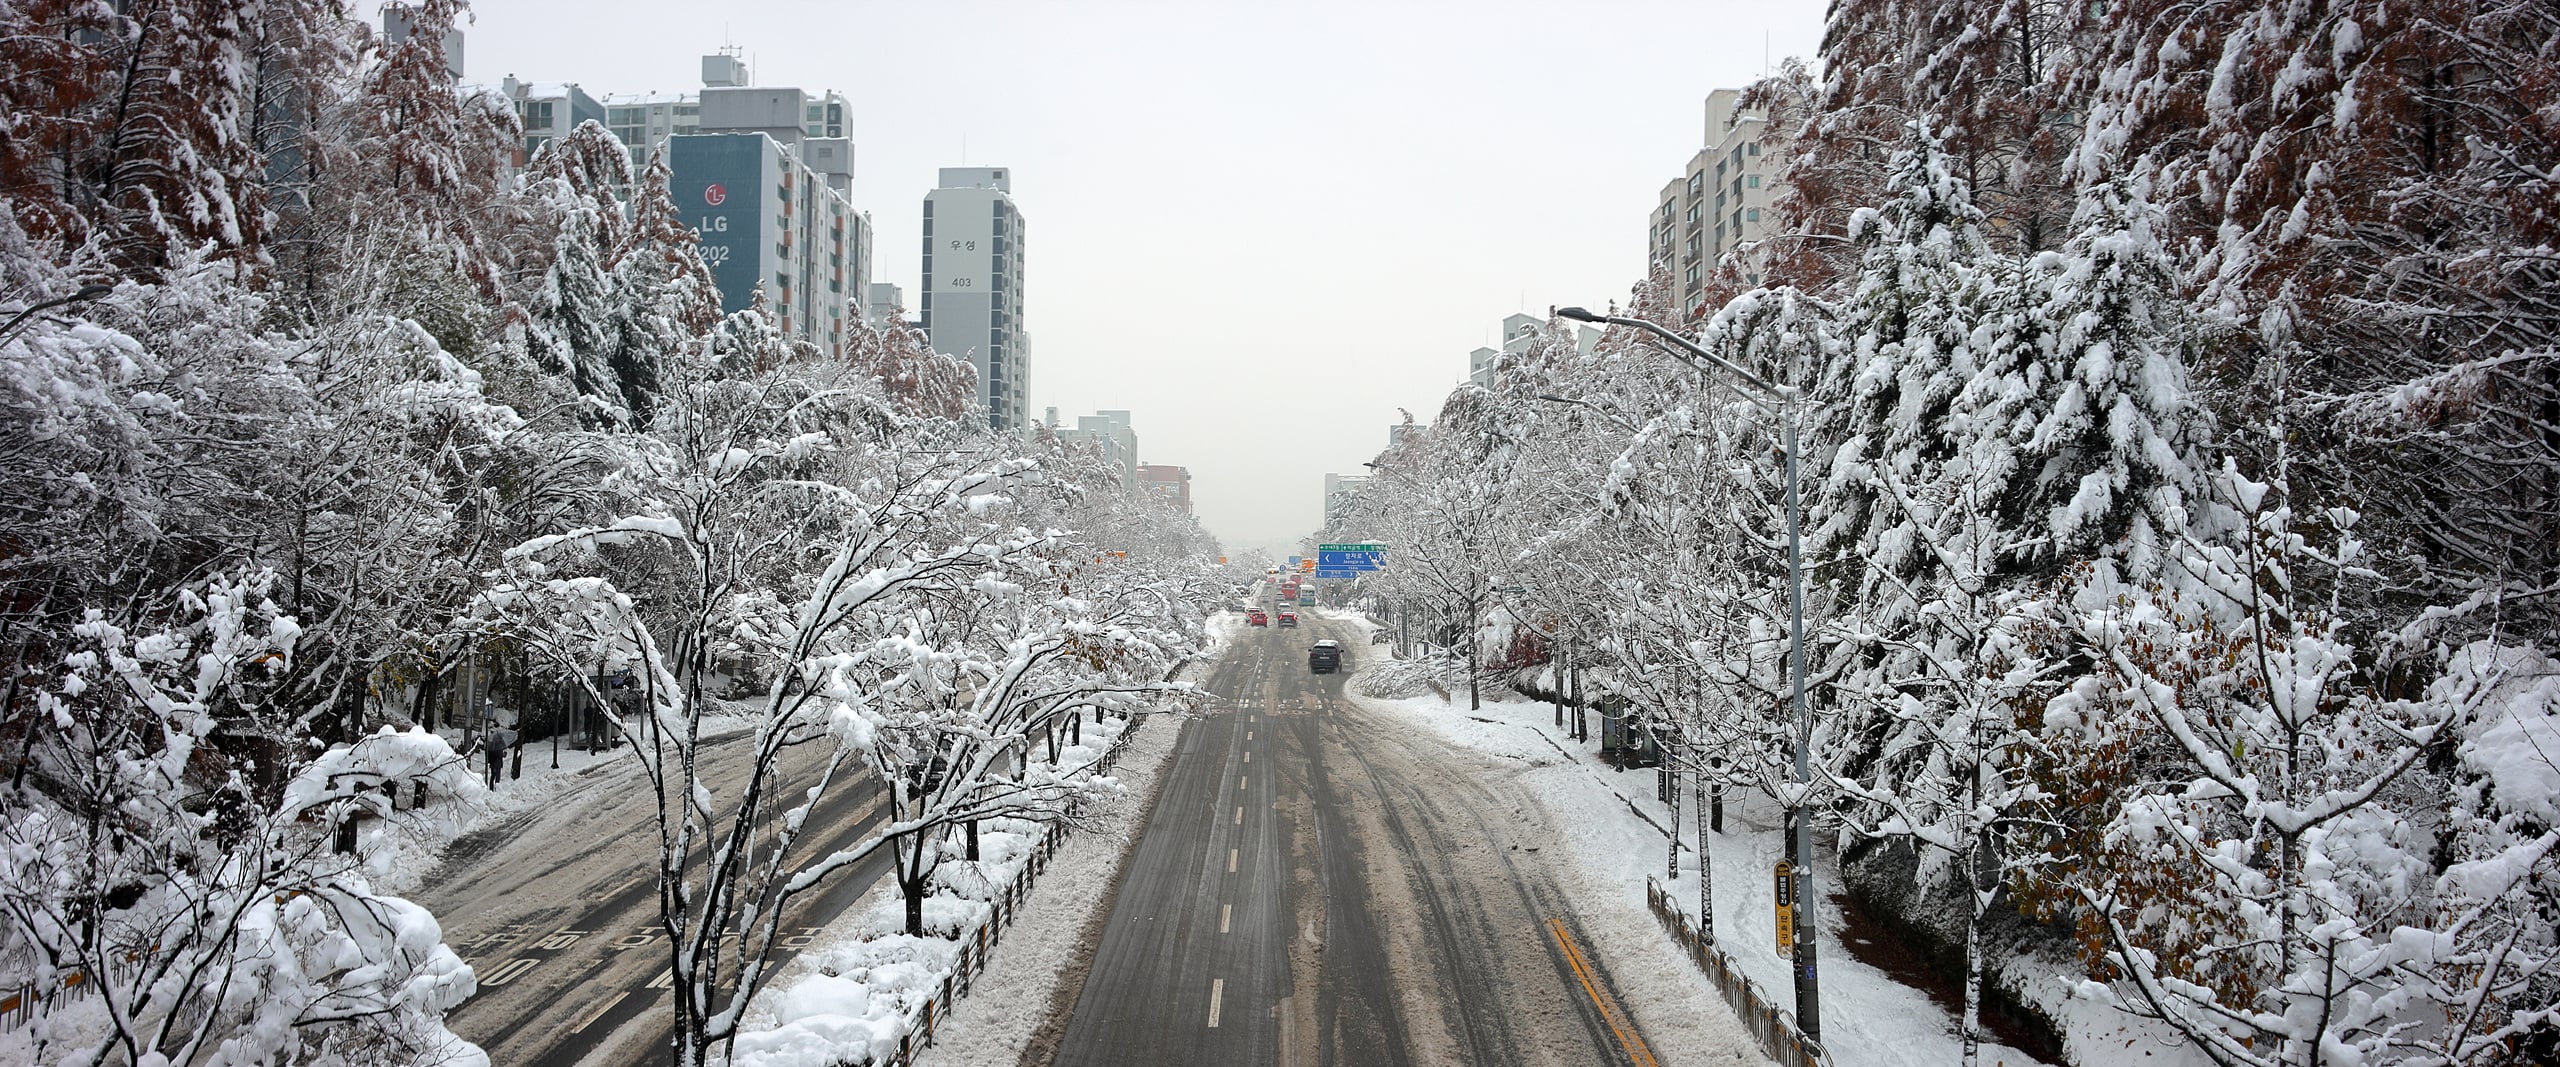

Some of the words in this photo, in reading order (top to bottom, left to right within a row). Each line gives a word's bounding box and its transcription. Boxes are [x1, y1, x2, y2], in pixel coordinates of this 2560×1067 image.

[702, 216, 728, 232] LG
[950, 240, 976, 251] 우성
[700, 246, 729, 261] 202
[952, 278, 972, 287] 403
